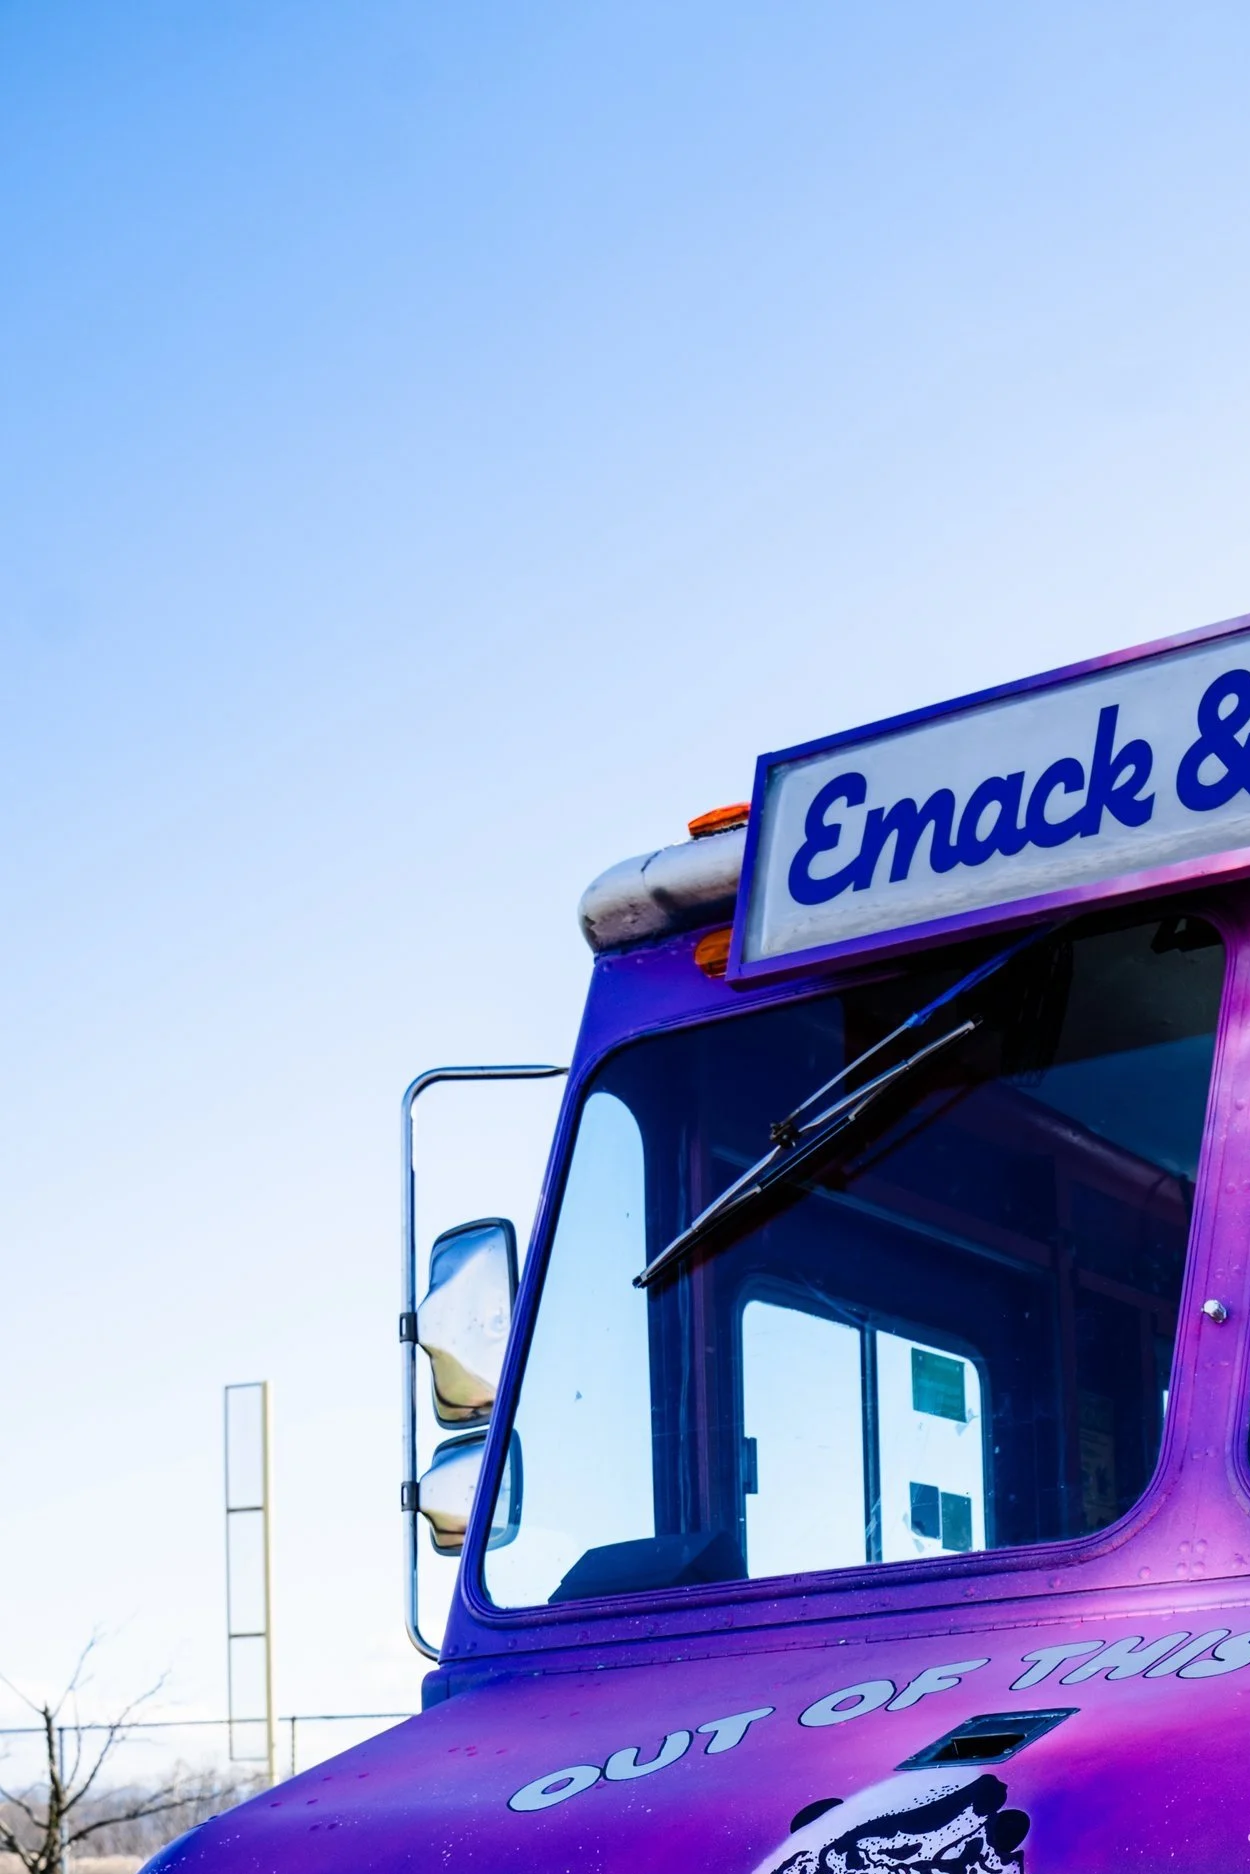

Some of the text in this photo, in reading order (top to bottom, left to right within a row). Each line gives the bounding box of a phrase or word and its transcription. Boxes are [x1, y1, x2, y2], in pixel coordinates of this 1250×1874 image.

[788, 704, 1155, 905] Emack
[505, 1705, 776, 1813] OUT
[798, 1656, 992, 1728] OF
